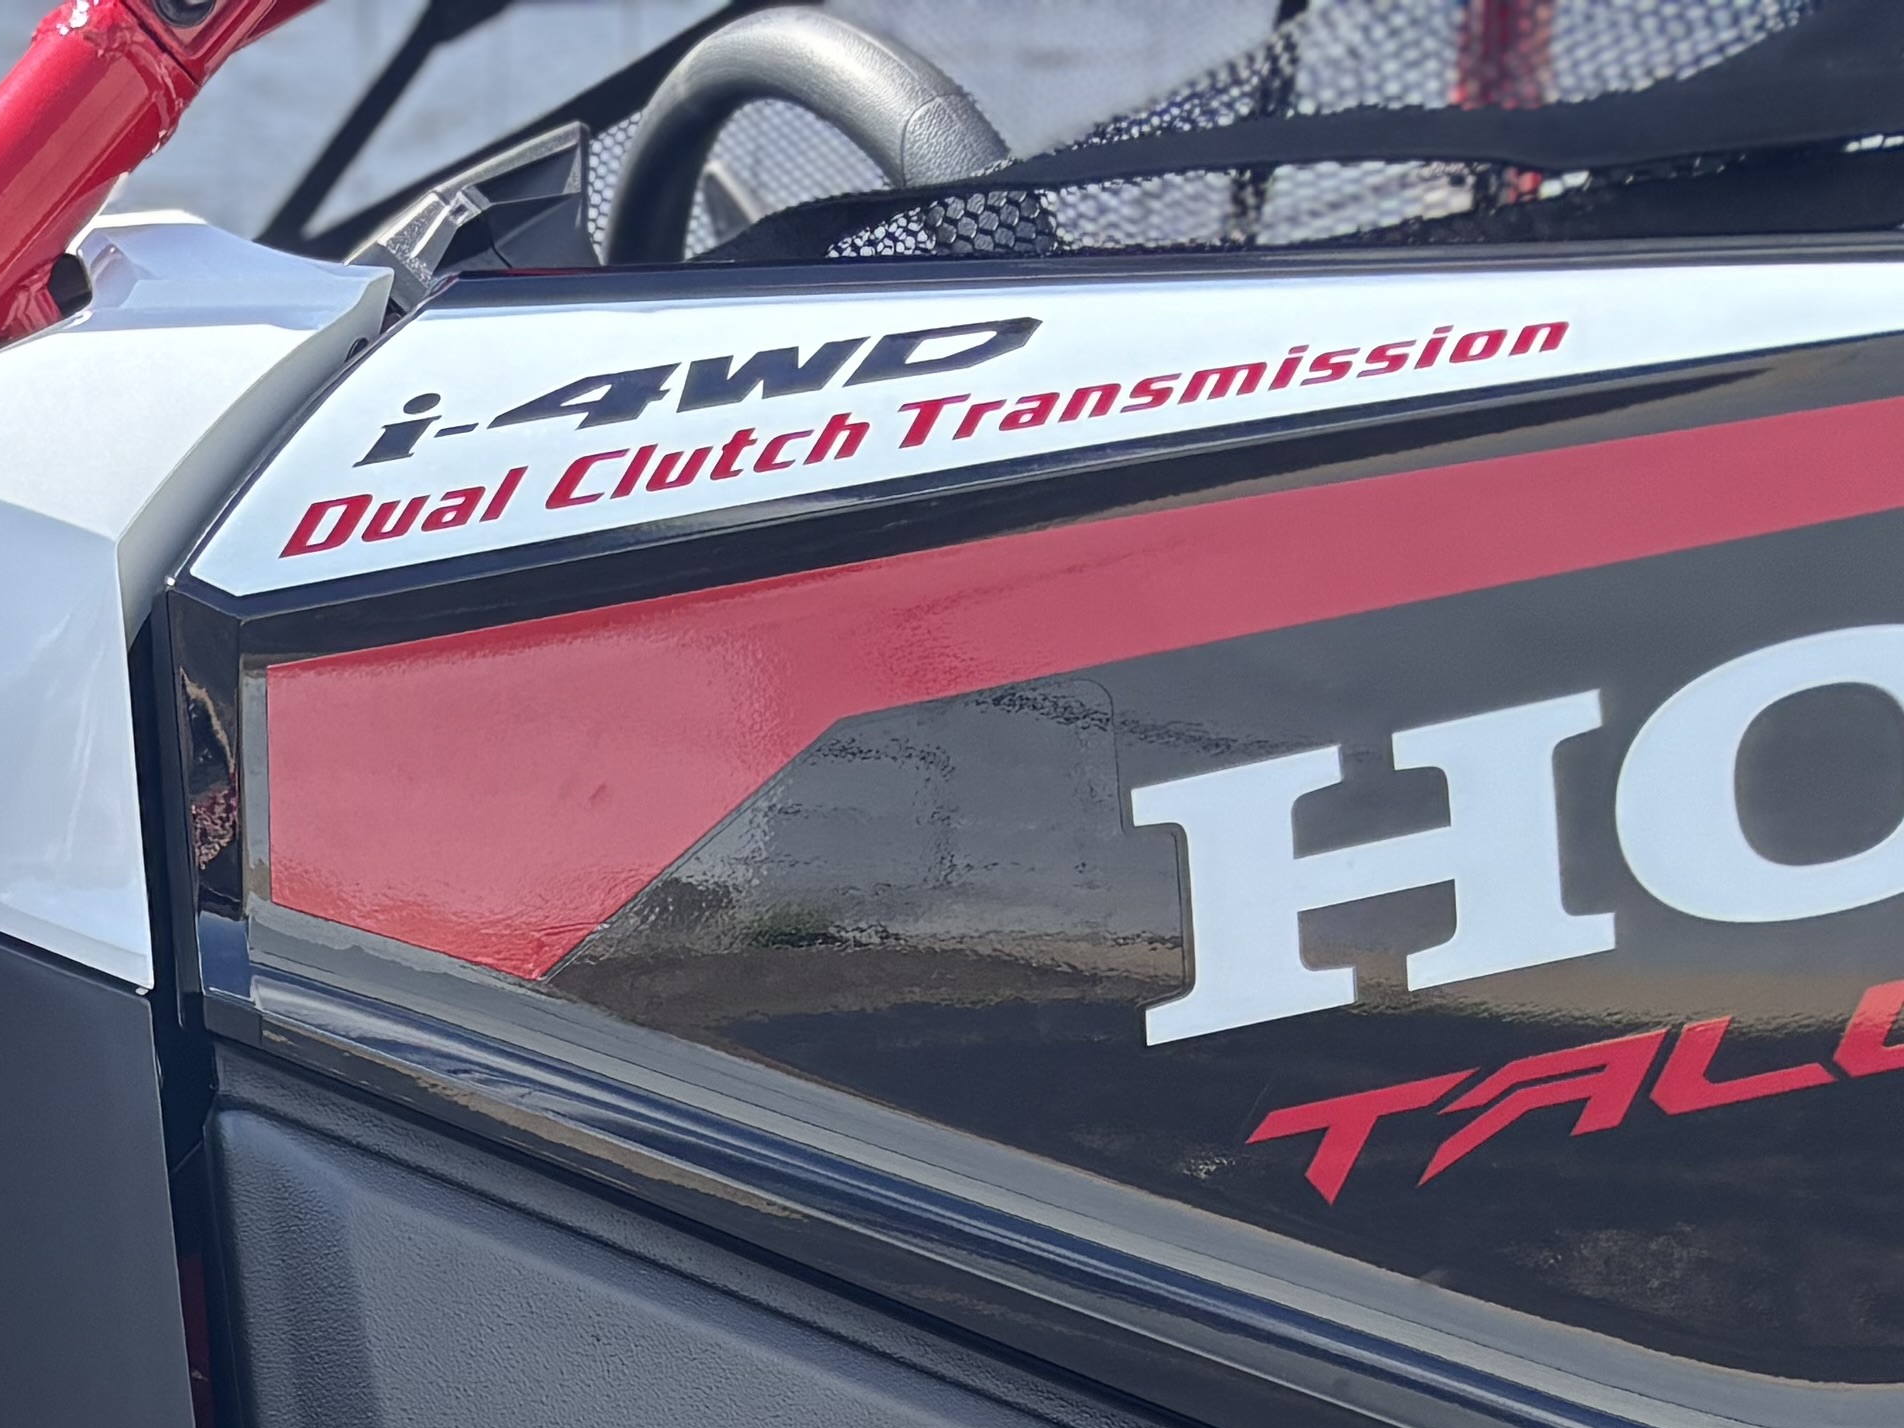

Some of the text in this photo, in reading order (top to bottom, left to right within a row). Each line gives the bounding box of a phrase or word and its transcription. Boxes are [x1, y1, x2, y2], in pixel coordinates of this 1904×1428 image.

[280, 320, 1570, 560] Dual Clutch Transmission
[352, 317, 1043, 469] i-4WD
